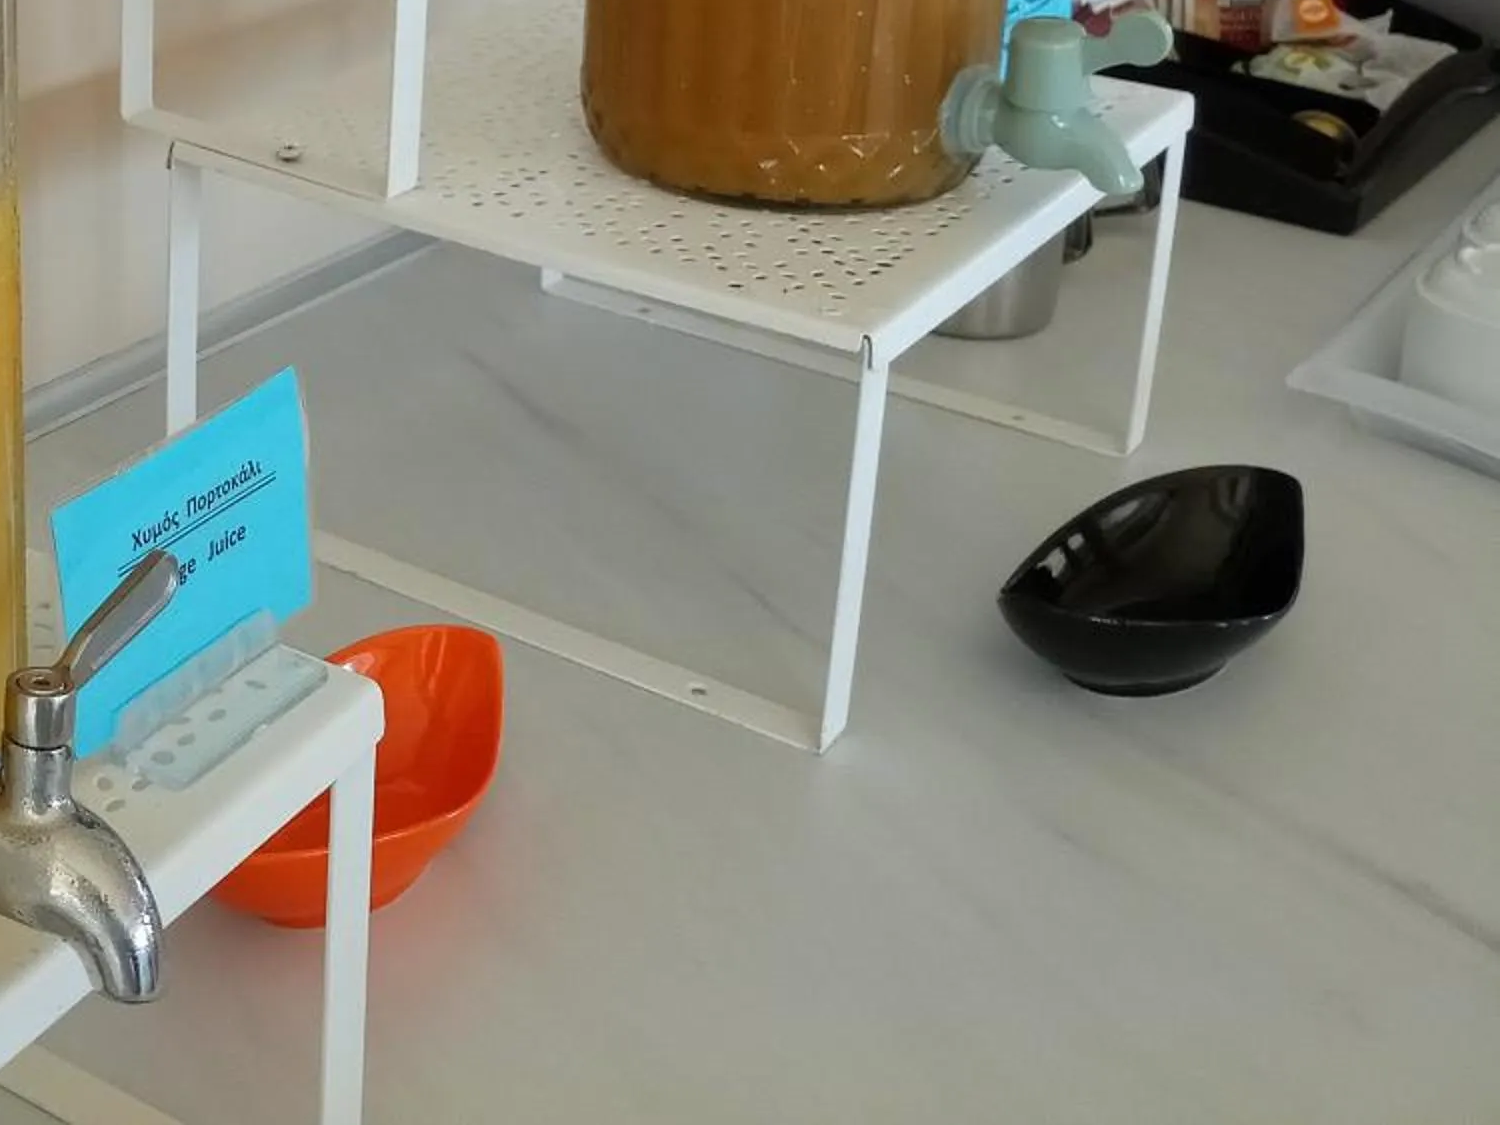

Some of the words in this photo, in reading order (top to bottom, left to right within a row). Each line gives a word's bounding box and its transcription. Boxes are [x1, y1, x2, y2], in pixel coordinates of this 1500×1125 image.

[131, 509, 180, 552] Χυμός
[186, 460, 262, 517] Πορτοκάλι
[208, 525, 246, 562] Juice
